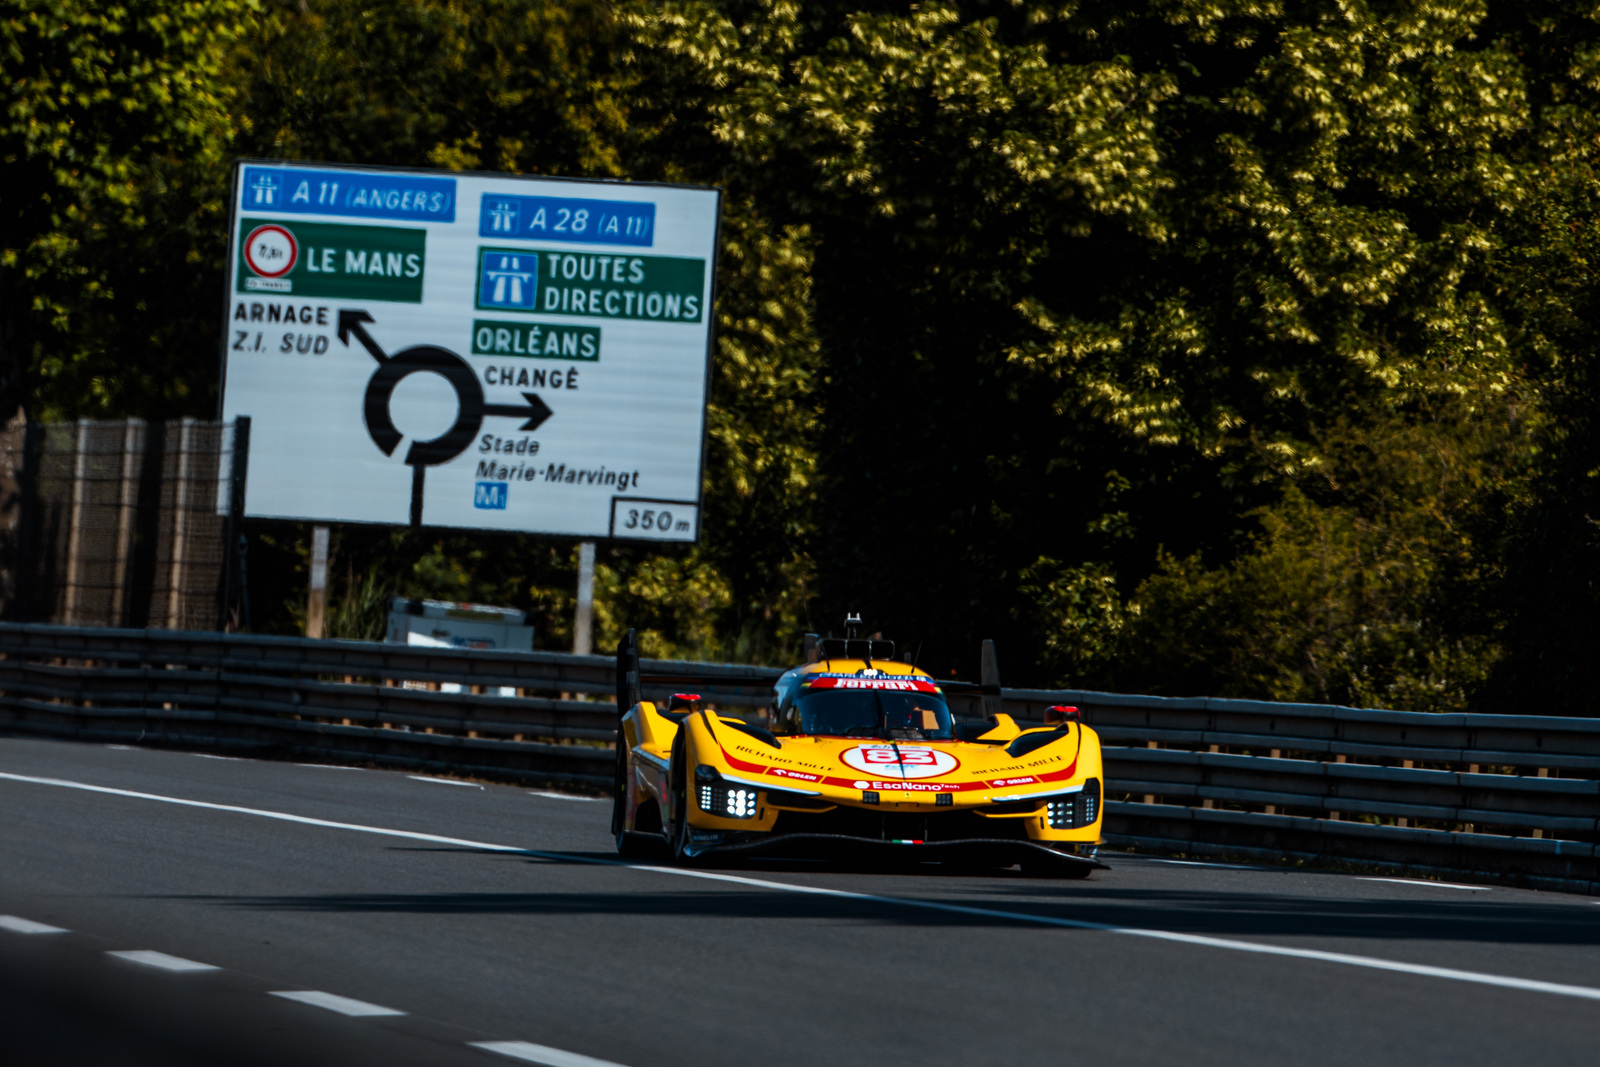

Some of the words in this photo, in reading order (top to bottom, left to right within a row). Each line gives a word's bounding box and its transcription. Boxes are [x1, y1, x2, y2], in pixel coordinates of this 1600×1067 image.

[292, 179, 310, 203] A
[318, 181, 339, 205] 11
[345, 185, 451, 214] (ANGERS)
[529, 207, 547, 230] A
[554, 208, 589, 235] 28
[306, 247, 337, 273] LE
[345, 250, 421, 278] MANS
[547, 254, 645, 284] TOUTES
[235, 302, 330, 326] ARNAGE
[544, 287, 699, 319] DIRECTIONS
[232, 330, 267, 353] Z.I.
[280, 332, 330, 355] SUD
[476, 325, 596, 358] ORLÉANS
[484, 366, 580, 390] CHANGÉ
[478, 434, 540, 456] Stade
[475, 459, 640, 491] Marie-Marvingt
[736, 745, 792, 763] RICHARD
[866, 749, 934, 764] 83
[787, 771, 817, 780] ORLEN
